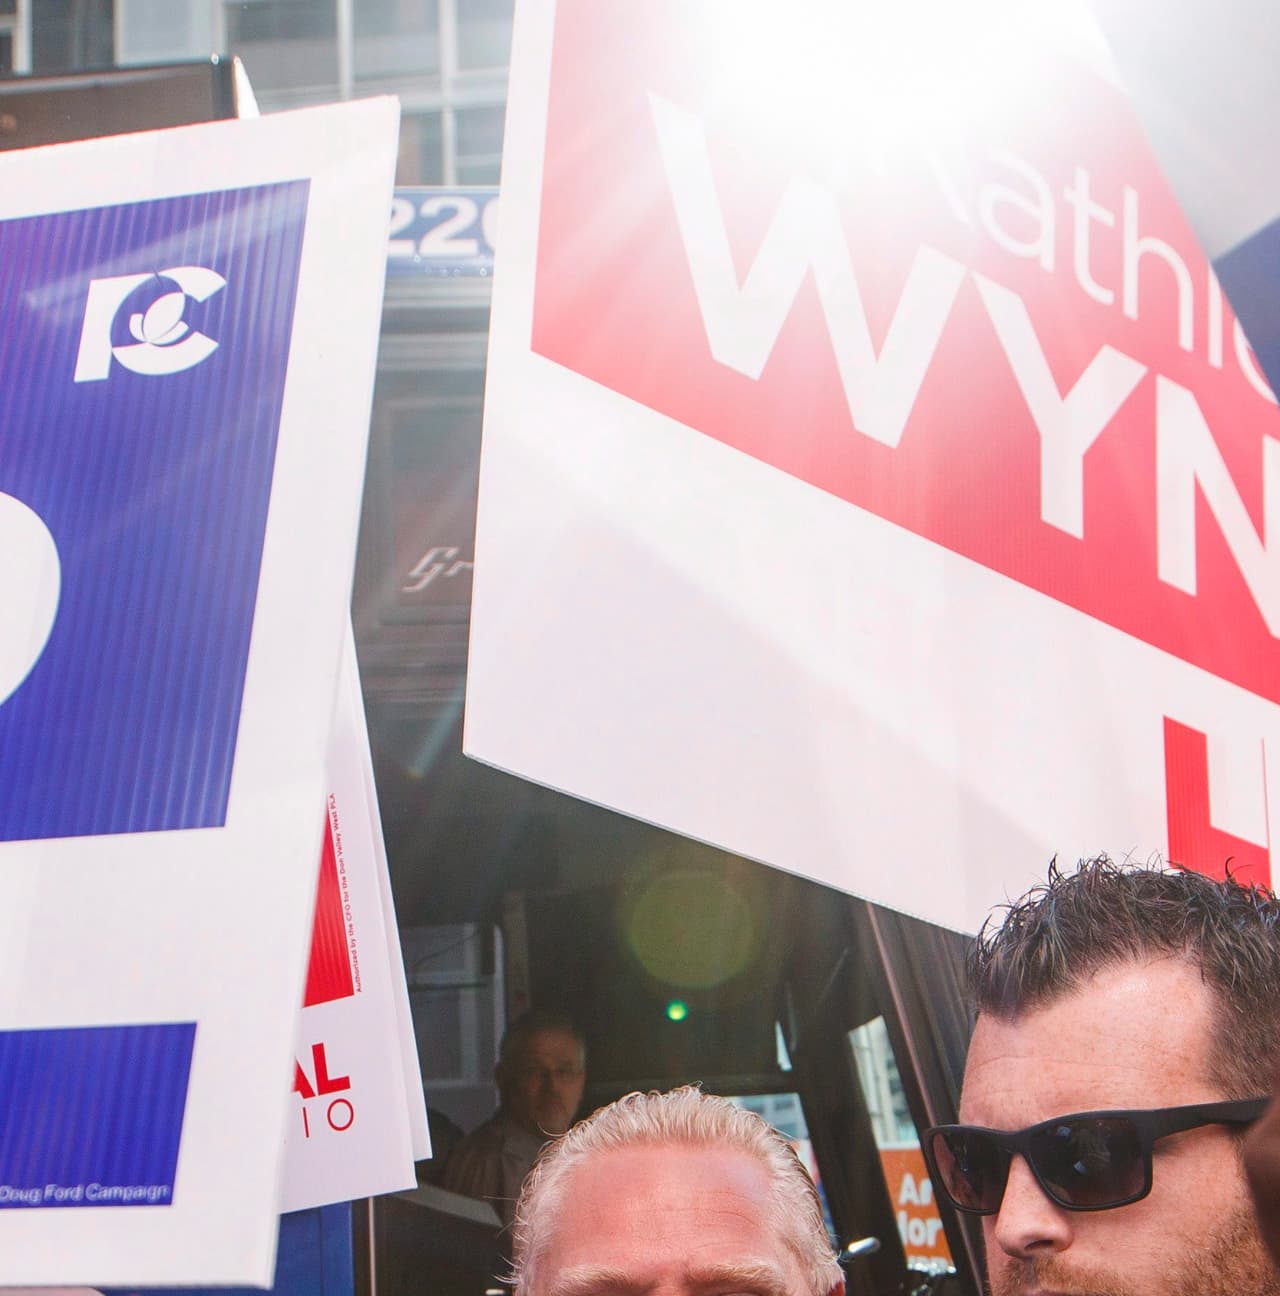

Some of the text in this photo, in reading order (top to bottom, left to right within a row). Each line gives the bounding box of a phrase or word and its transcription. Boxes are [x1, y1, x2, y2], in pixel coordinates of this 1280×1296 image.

[335, 833, 344, 857] Valley
[344, 904, 353, 922] CFO
[351, 949, 362, 993] Authorized
[44, 1184, 82, 1200] Ford
[85, 1182, 168, 1202] Campaign
